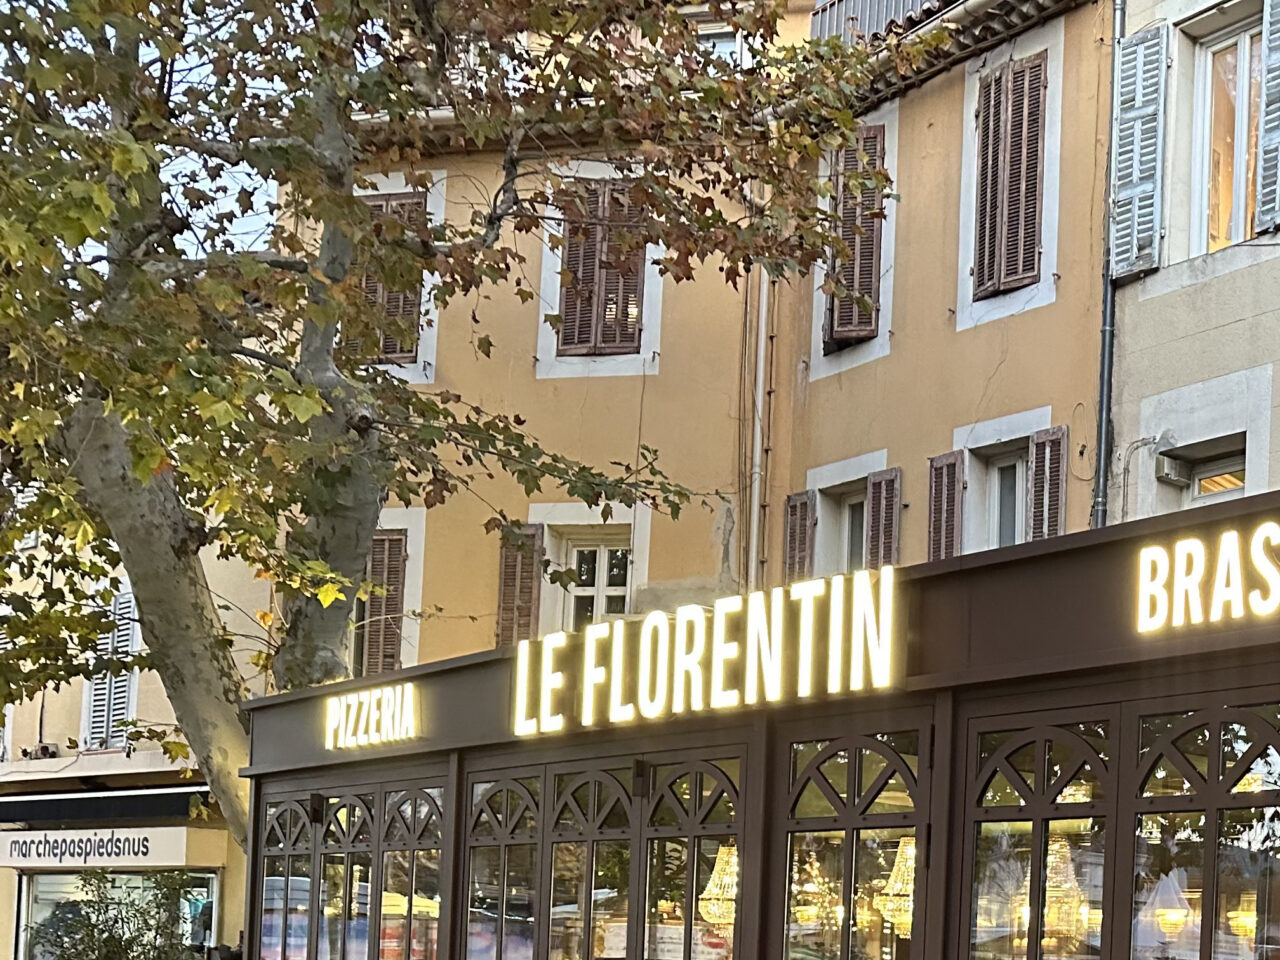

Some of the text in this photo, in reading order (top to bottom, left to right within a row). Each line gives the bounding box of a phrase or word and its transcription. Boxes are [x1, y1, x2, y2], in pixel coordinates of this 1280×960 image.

[514, 565, 895, 736] LE FLORENTIN
[325, 682, 415, 750] PIZZERIA
[10, 830, 149, 864] marchepaspiedsnus
